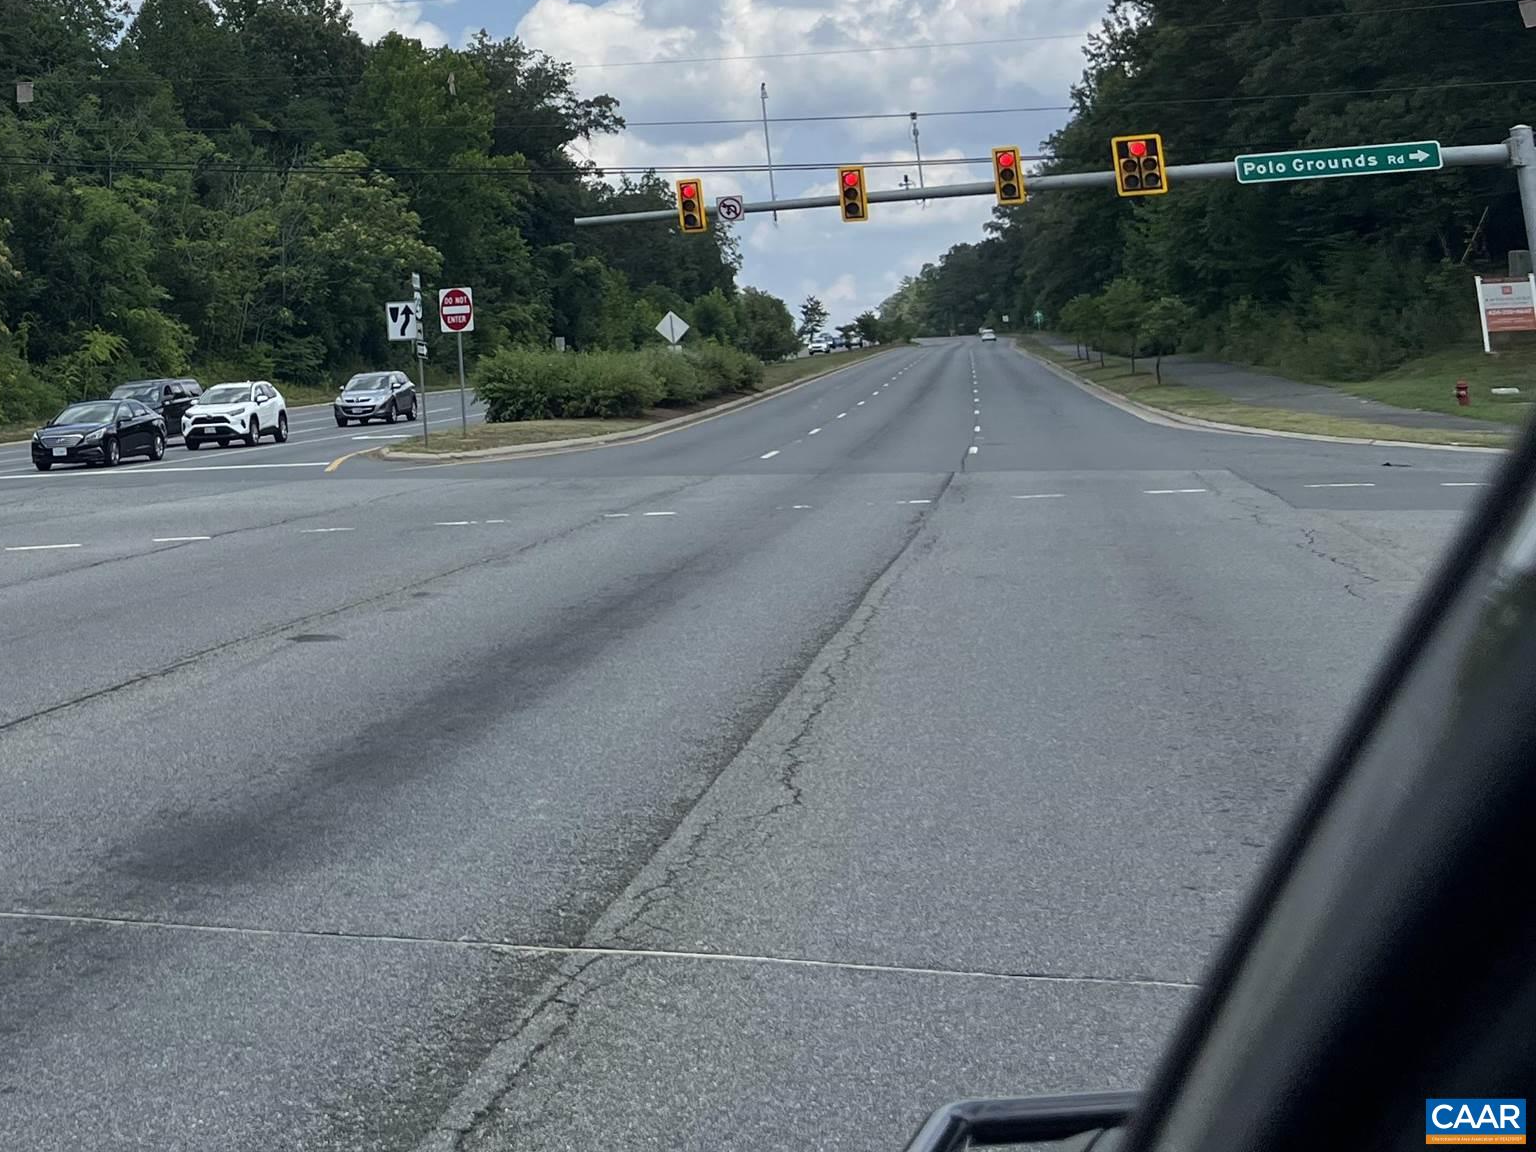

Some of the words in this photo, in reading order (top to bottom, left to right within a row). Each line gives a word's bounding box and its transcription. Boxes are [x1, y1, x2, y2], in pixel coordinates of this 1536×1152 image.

[1243, 161, 1286, 175] Polo
[1292, 154, 1378, 171] Grounds
[1387, 154, 1405, 165] Rd
[444, 296, 453, 305] DO
[454, 295, 467, 305] NOT
[447, 315, 467, 324] ENTER
